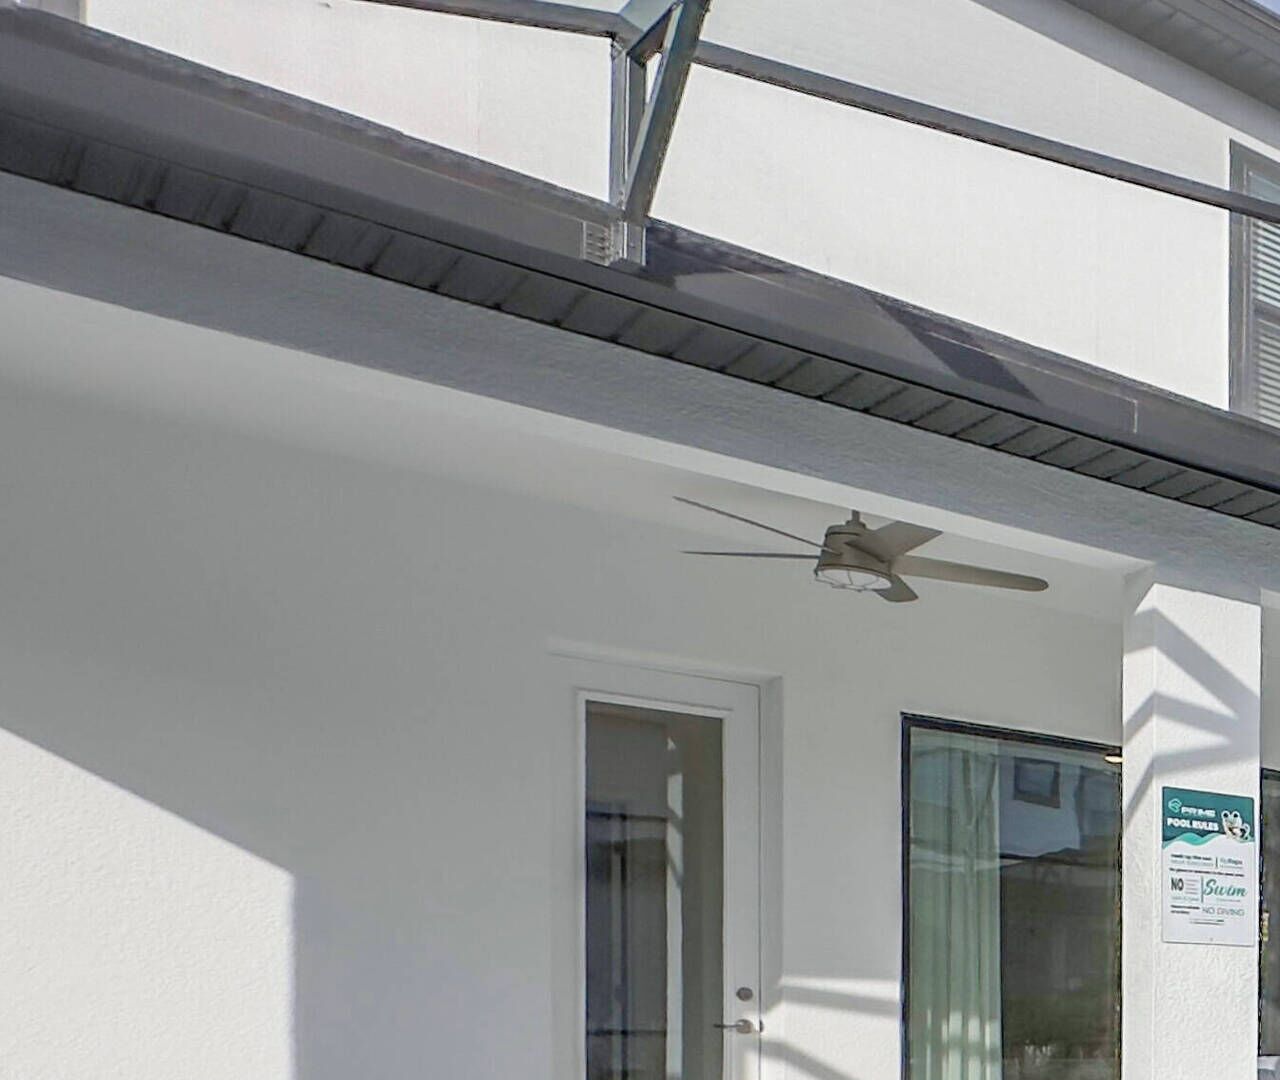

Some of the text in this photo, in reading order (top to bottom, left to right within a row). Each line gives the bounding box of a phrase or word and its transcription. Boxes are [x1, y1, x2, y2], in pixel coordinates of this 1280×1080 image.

[1167, 817, 1219, 831] POOL RULES
[1170, 877, 1184, 891] NO
[1203, 879, 1247, 897] Swim
[1202, 906, 1215, 915] NO
